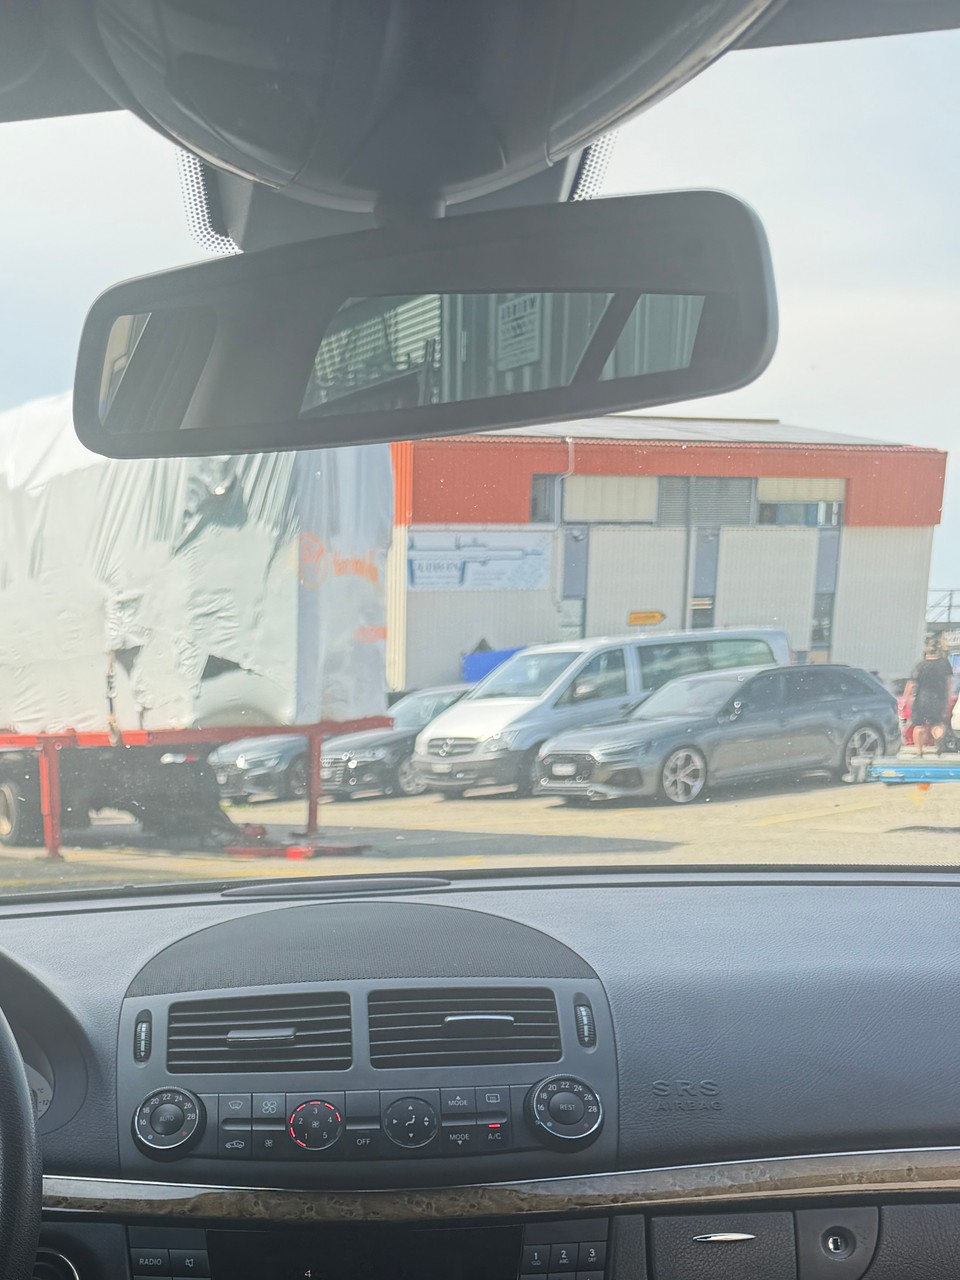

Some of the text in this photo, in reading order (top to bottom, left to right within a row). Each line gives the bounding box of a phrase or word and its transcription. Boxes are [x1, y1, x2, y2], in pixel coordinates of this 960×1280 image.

[652, 1079, 721, 1097] SRS
[534, 1252, 538, 1260] 1
[561, 1250, 567, 1258] 2
[305, 1270, 312, 1278] 4
